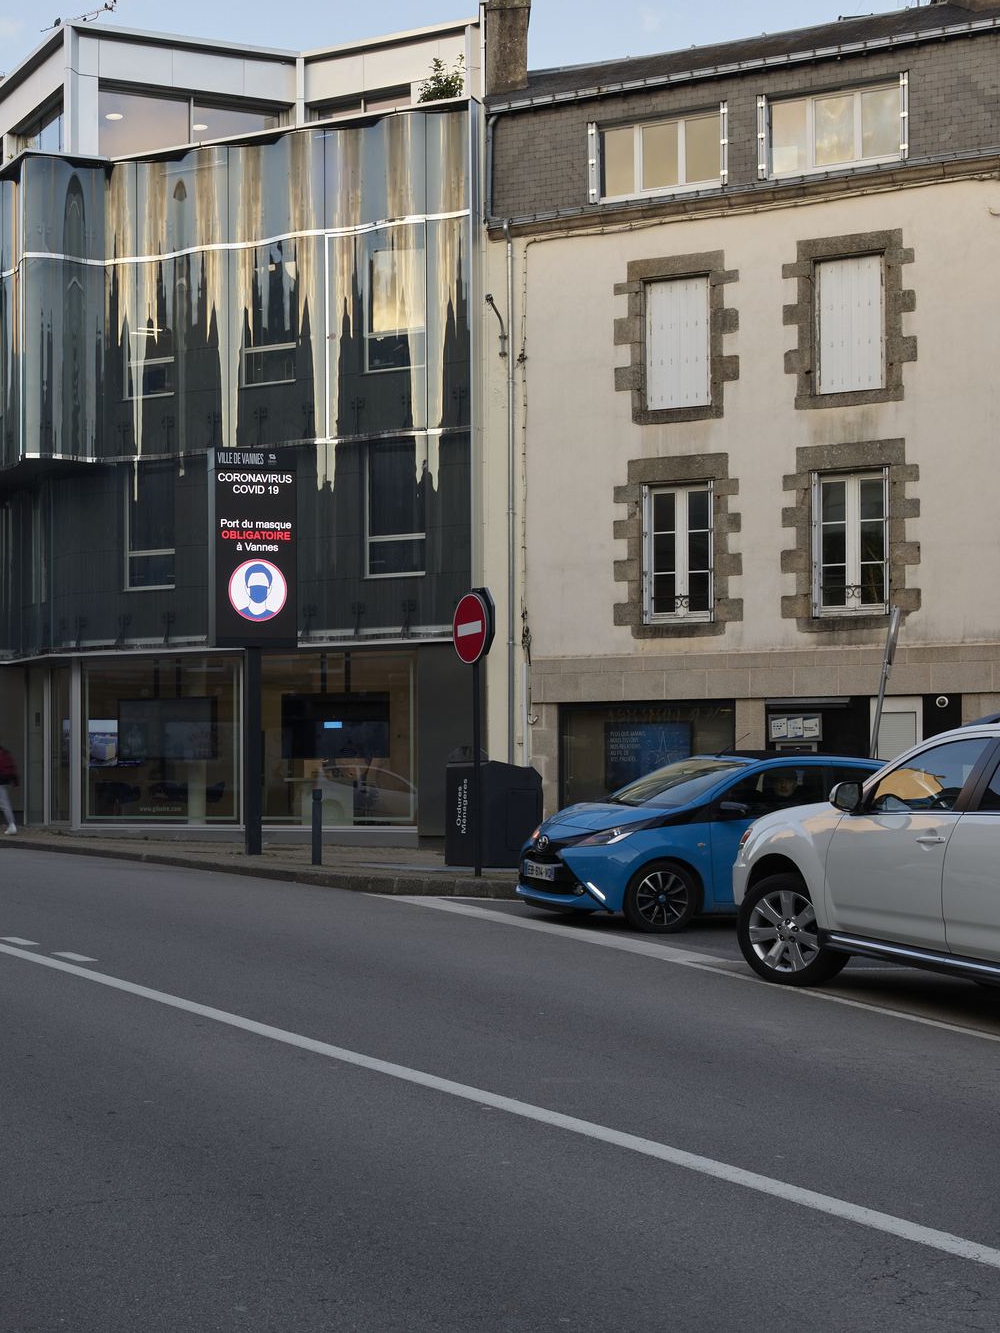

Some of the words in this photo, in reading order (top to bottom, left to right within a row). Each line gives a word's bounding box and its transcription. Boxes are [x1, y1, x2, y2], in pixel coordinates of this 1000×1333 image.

[217, 451, 233, 464] VILLE
[233, 452, 241, 464] DE
[241, 452, 264, 465] VANNES
[217, 472, 293, 484] CORONAVIRUS
[232, 484, 265, 495] COVID
[267, 485, 279, 495] 19
[220, 518, 239, 528] Port
[241, 519, 253, 529] du
[255, 520, 292, 531] masque
[221, 530, 291, 541] OBLIGATOIRE
[236, 542, 242, 551] à
[244, 542, 279, 552] Vannes
